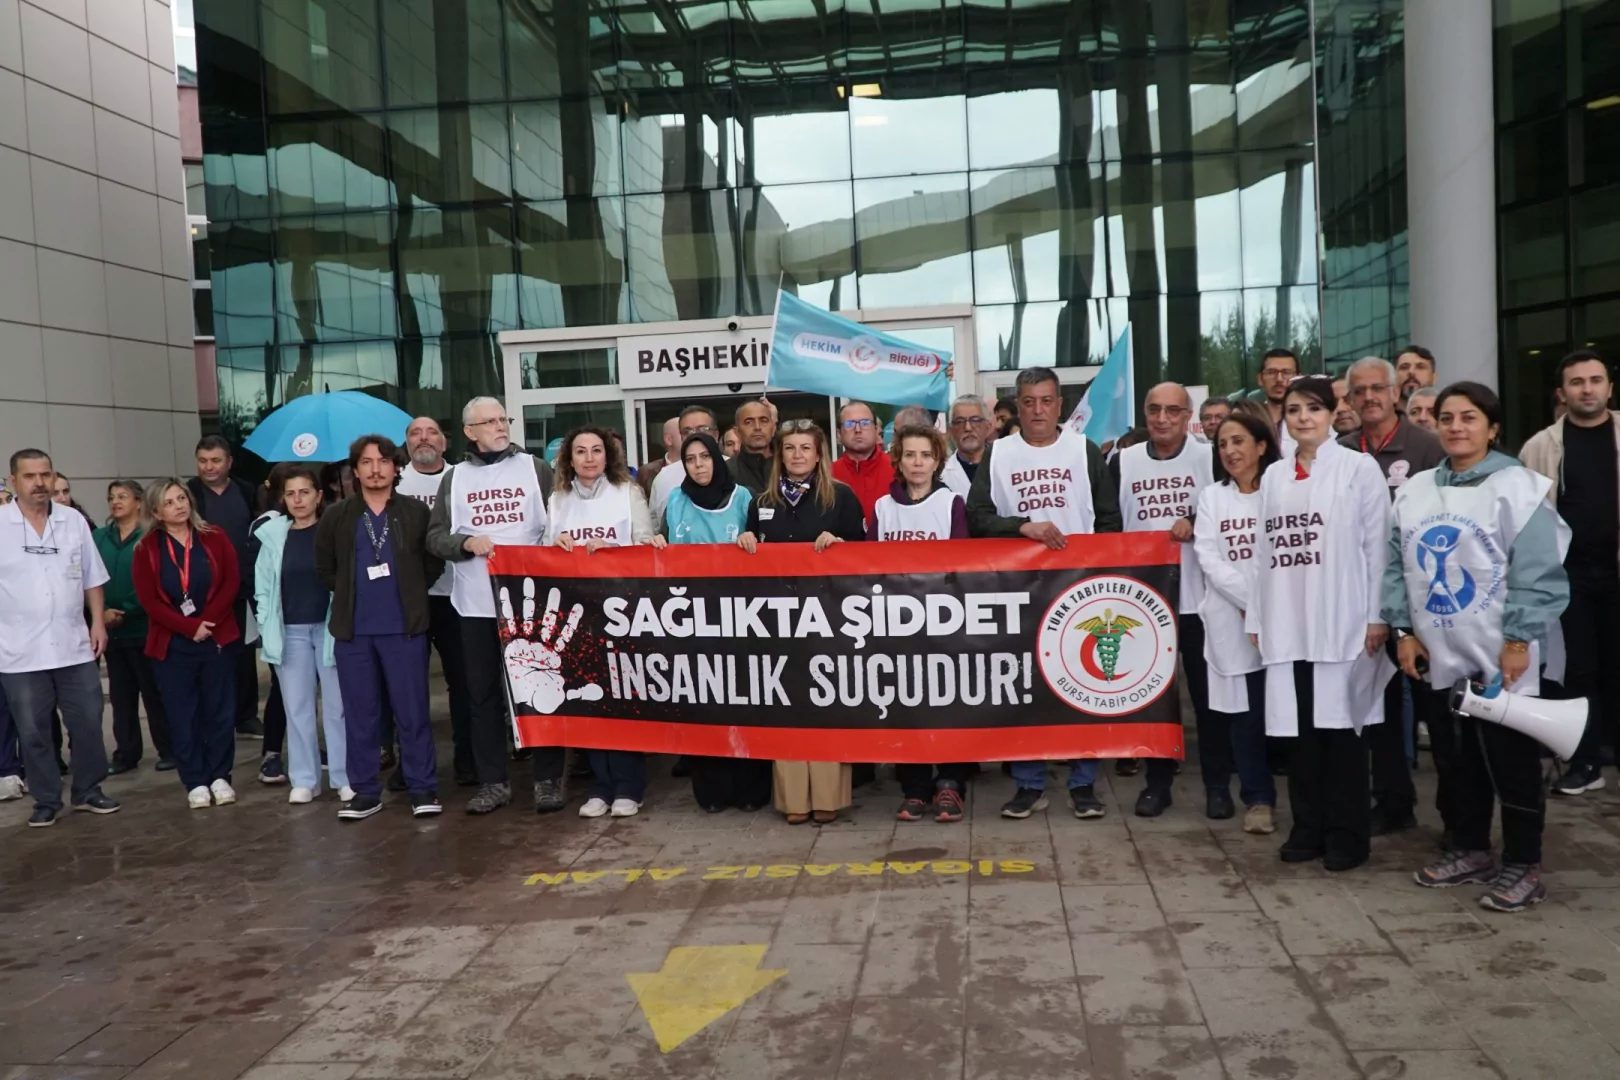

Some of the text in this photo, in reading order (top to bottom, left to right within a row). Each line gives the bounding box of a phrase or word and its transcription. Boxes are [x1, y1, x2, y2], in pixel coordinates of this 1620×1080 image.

[801, 338, 929, 367] HEKİM BİRLİĞİ
[1011, 468, 1073, 486] BURSA
[1132, 476, 1196, 494] BURSA
[467, 488, 525, 503] BURSA
[1018, 481, 1066, 498] TABİP
[1137, 491, 1190, 506] TABİP
[473, 501, 520, 513] TABİP
[1137, 505, 1193, 521] ODASI
[472, 512, 524, 526] ODASI
[1265, 512, 1324, 533] BURSA
[561, 527, 617, 541] URSA
[1047, 582, 1171, 632] TÜRK TABİPLERİ BİRLİĞİ
[603, 583, 1031, 650] SAĞLIKTA ŞİDDET
[606, 641, 1033, 720] İNSANLIK SUÇUDUR!
[1056, 673, 1164, 709] BURSA TABİP ODASI
[523, 866, 687, 886] ALAN
